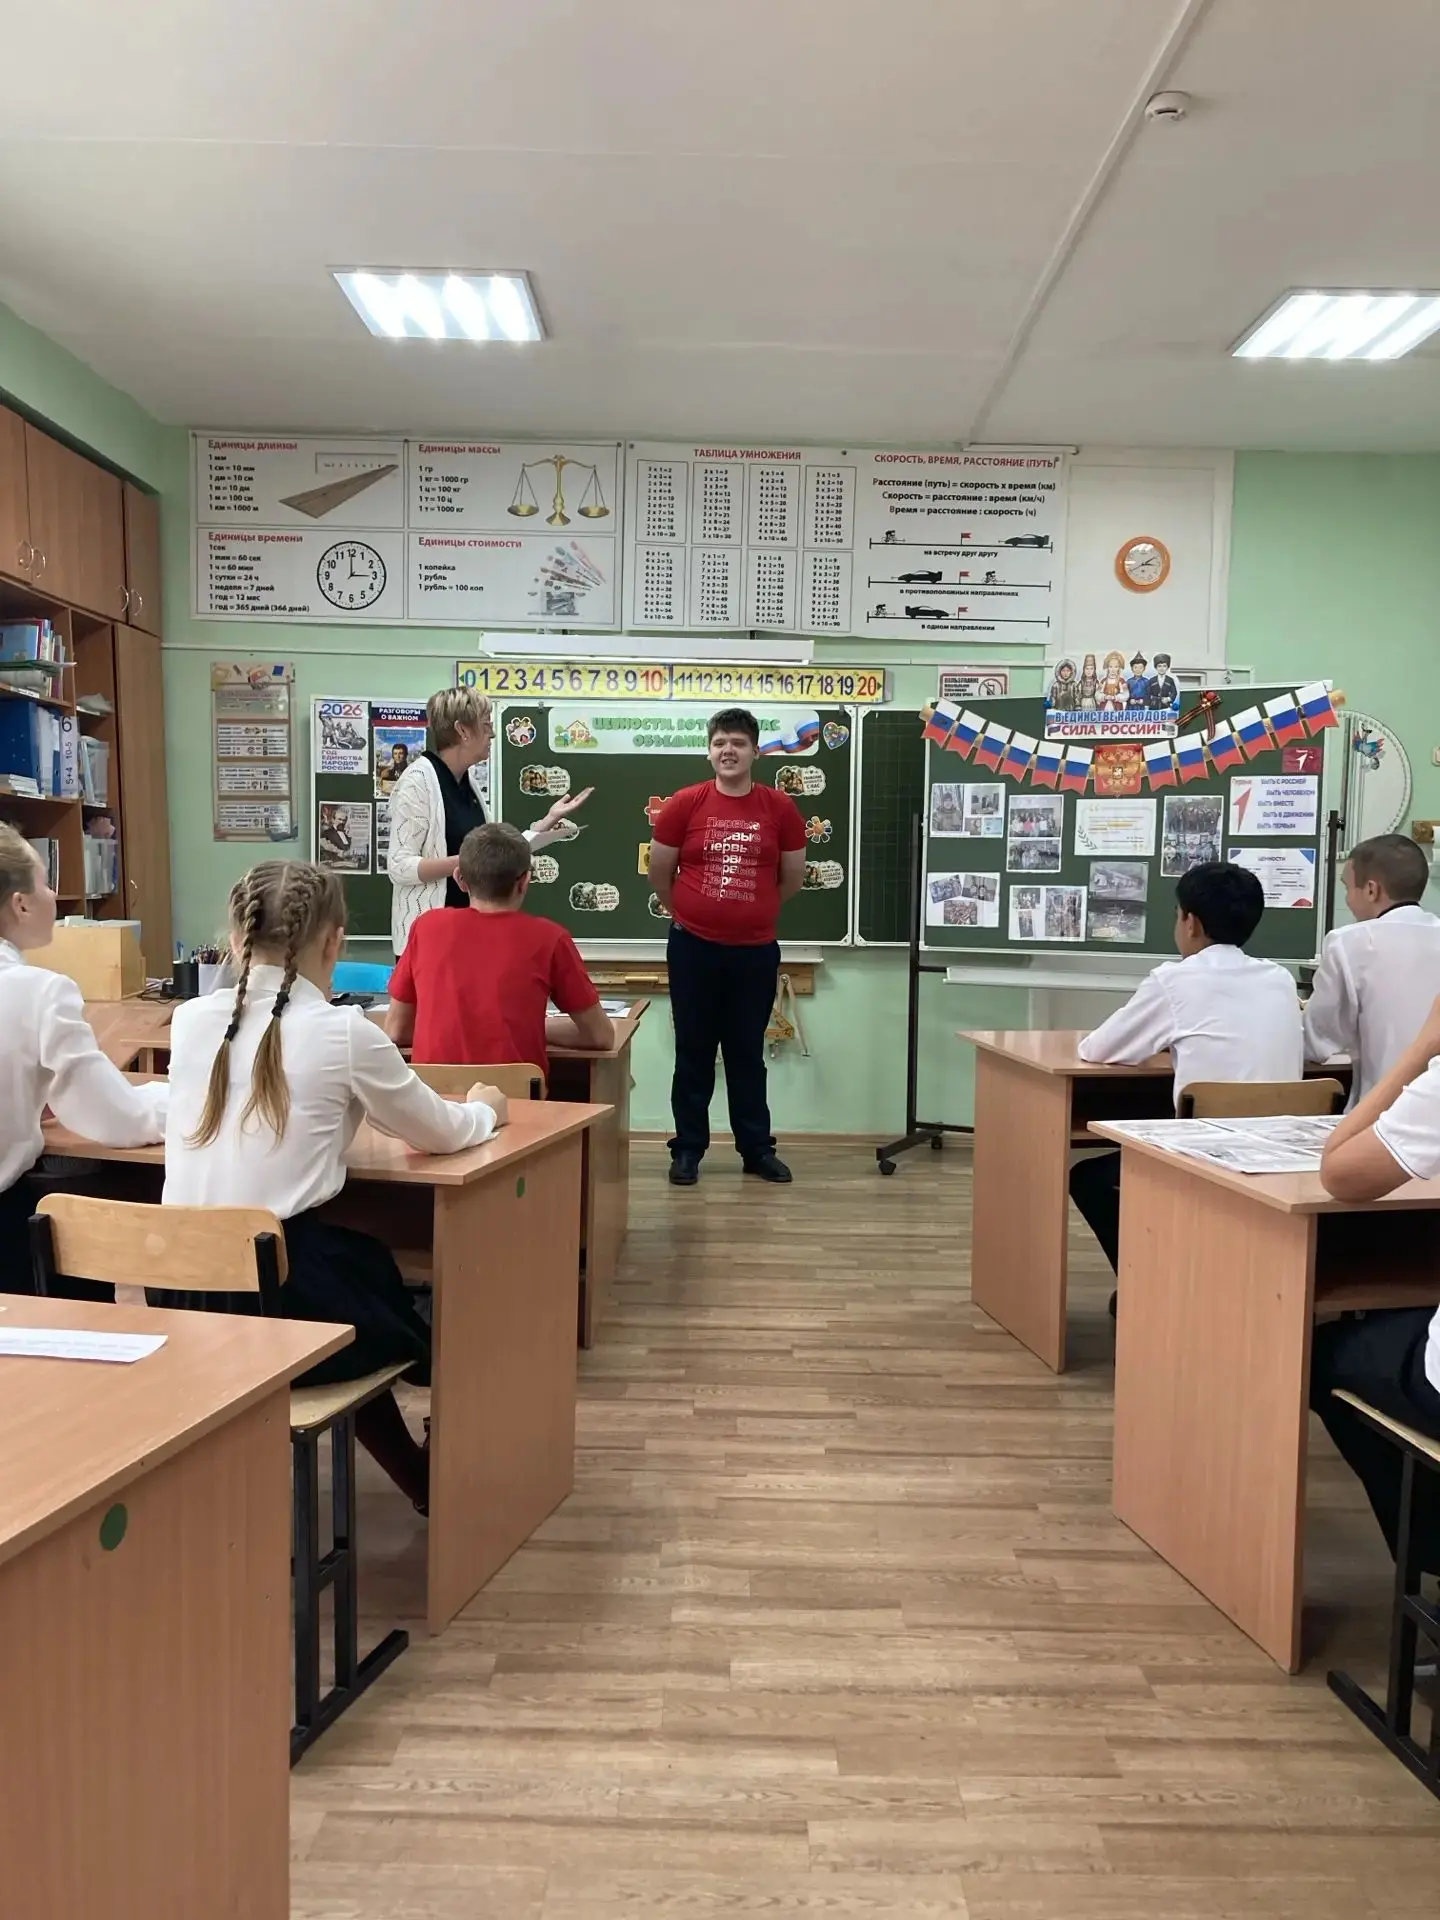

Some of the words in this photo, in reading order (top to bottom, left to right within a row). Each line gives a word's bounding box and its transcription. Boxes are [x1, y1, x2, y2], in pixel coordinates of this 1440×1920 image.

[208, 440, 256, 451] Единицы
[419, 444, 467, 455] Единицы
[469, 446, 501, 455] массы
[694, 449, 738, 459] ТАБЛИЦА
[740, 449, 802, 461] УМНОЖЕНИЯ
[874, 454, 926, 465] СКОРОСТЬ,
[928, 456, 962, 466] ВРЕМЯ,
[963, 457, 1025, 467] РАССТОЯНИЕ
[441, 475, 459, 483] 1000
[872, 477, 924, 487] Расстояние
[925, 479, 951, 489] (путь)
[959, 482, 1000, 491] скорость
[1008, 483, 1037, 491] время
[1038, 481, 1056, 491] (км)
[882, 491, 924, 502] Скорость
[932, 494, 984, 502] расстояние
[1019, 494, 1045, 504] (км/ч)
[889, 505, 918, 515] Время
[927, 508, 978, 516] расстояние
[983, 509, 1024, 517] скорость
[1025, 508, 1037, 517] (ч)
[208, 532, 256, 543] Единицы
[257, 535, 303, 544] времени
[419, 537, 466, 548] Единицы
[467, 540, 522, 549] стоимости
[335, 551, 344, 560] 11
[347, 548, 356, 558] 12
[360, 551, 364, 560] 1
[327, 559, 336, 569] 10
[368, 559, 374, 569] 2
[424, 563, 456, 571] копейка
[325, 571, 330, 580] 9
[372, 571, 377, 580] 3
[424, 573, 447, 582] рубль
[328, 582, 334, 592] 8
[369, 582, 374, 592] 4
[424, 583, 447, 592] рубль
[337, 591, 343, 600] 7
[349, 593, 354, 603] 6
[360, 590, 365, 600] 5
[464, 669, 476, 688] 0
[479, 668, 489, 690] 1
[496, 668, 510, 691] 2
[515, 668, 527, 691] 3
[532, 669, 546, 691] 4
[552, 669, 564, 691] 5
[570, 669, 582, 691] 6
[588, 669, 601, 691] 7
[606, 669, 619, 691] 8
[624, 669, 637, 692] 9
[640, 670, 663, 692] 10
[678, 671, 692, 692] 11
[696, 672, 713, 693] 12
[716, 672, 732, 693] 13
[736, 673, 753, 694] 14
[757, 673, 774, 694] 15
[777, 674, 794, 695] 16
[797, 674, 814, 695] 17
[817, 675, 834, 696] 18
[837, 675, 854, 696] 19
[857, 675, 877, 696] 20
[321, 703, 363, 716] 2026
[379, 707, 421, 715] РАЗГОВОРЫ
[1055, 711, 1063, 723] В
[1064, 711, 1116, 723] ЕДИНСТВЕ
[1117, 710, 1167, 722] НАРОДОВ
[62, 716, 72, 733] 6
[1061, 724, 1096, 736] СИЛА
[1101, 723, 1161, 735] РОССИИ!
